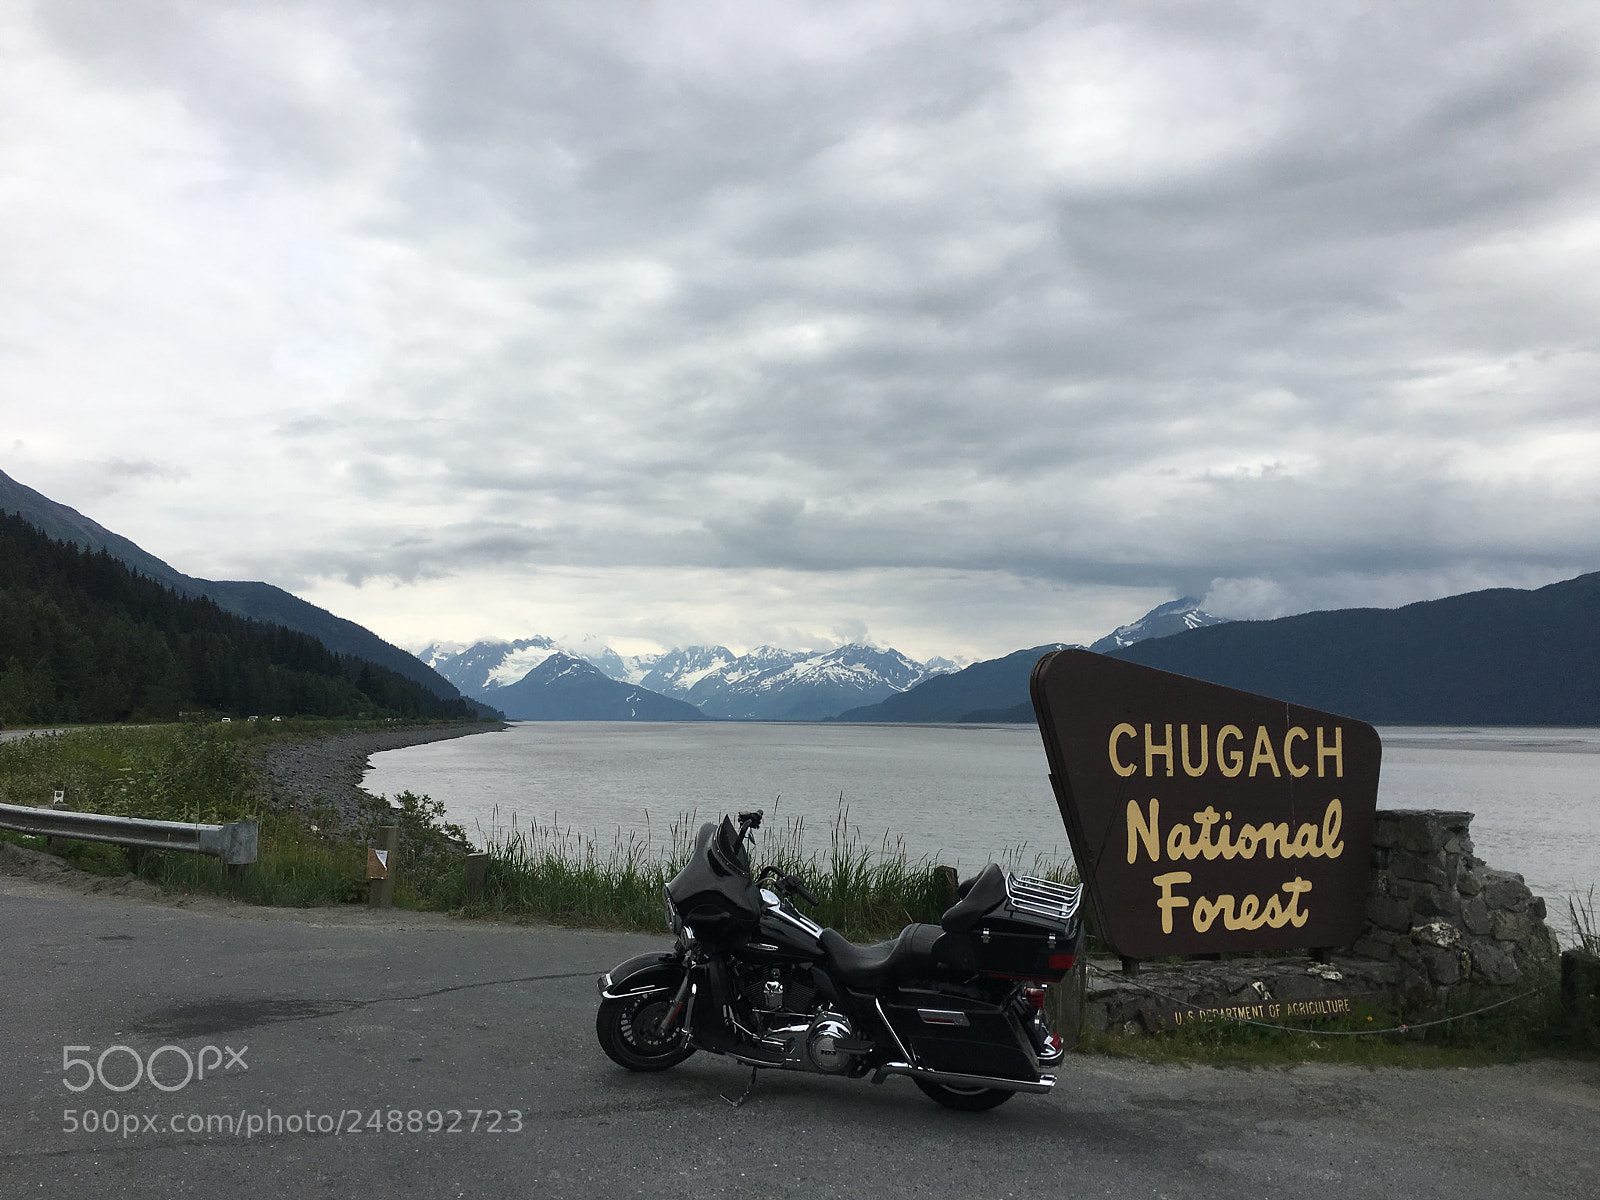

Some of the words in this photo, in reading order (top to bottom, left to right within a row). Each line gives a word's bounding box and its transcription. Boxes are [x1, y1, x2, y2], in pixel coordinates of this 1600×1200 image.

[1108, 722, 1344, 778] CHUGACH
[1126, 798, 1345, 864] National
[1152, 871, 1313, 934] Forest
[1268, 1004, 1281, 1018] OF
[1287, 999, 1351, 1016] AGRICULTURE
